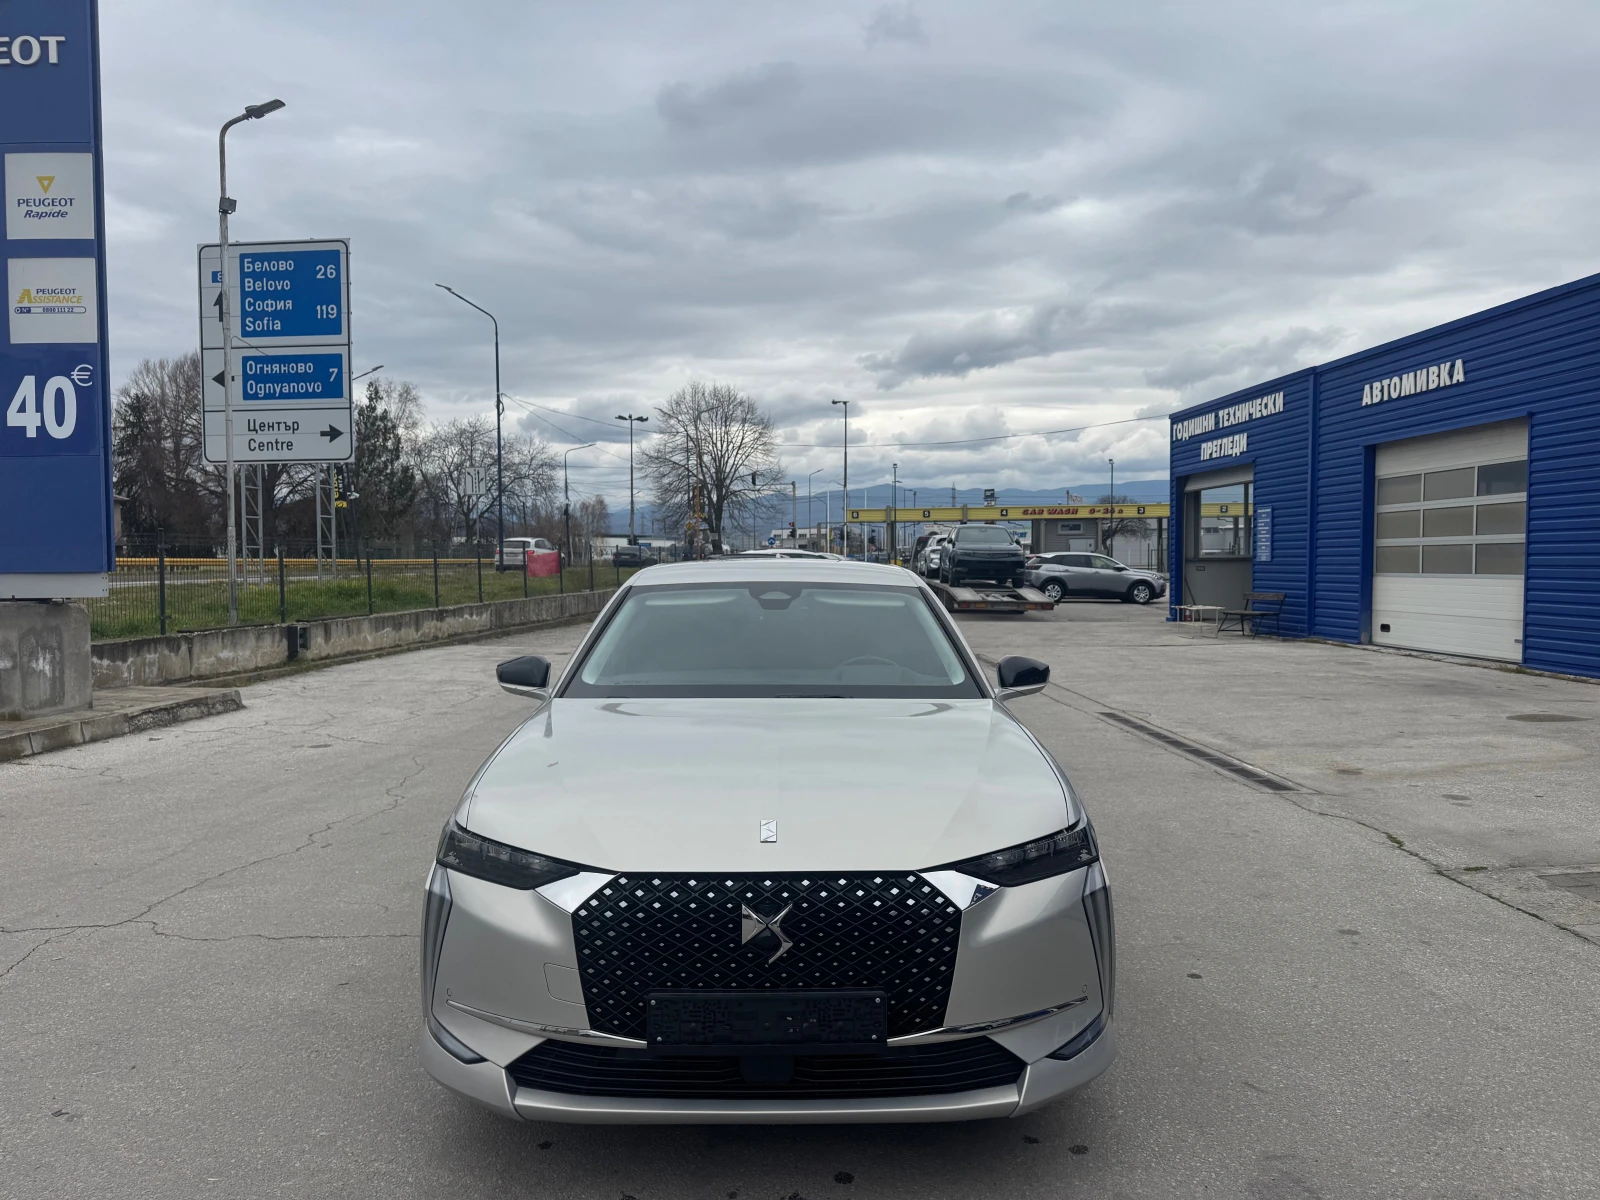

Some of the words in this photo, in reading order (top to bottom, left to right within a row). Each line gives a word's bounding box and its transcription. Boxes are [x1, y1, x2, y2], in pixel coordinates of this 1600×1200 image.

[17, 197, 75, 208] PEUGEOT
[23, 209, 69, 220] Rapide
[244, 258, 295, 273] Белово
[316, 264, 337, 279] 26
[245, 277, 291, 291] Belovo
[36, 288, 77, 296] PEUGEOT
[245, 297, 293, 313] София
[316, 304, 337, 319] 119
[245, 317, 281, 331] Sofia
[247, 360, 314, 375] Огняново
[329, 368, 338, 382] 7
[247, 380, 322, 397] Ognyanovo
[1362, 358, 1466, 407] АВТОМИВКА
[1173, 412, 1216, 442] ГОДИШНИ
[1219, 391, 1284, 428] ТЕХНИЧЕСКИ
[247, 418, 300, 434] Център
[248, 437, 294, 452] Centre
[1201, 432, 1248, 461] ПРЕГЛЕДИ
